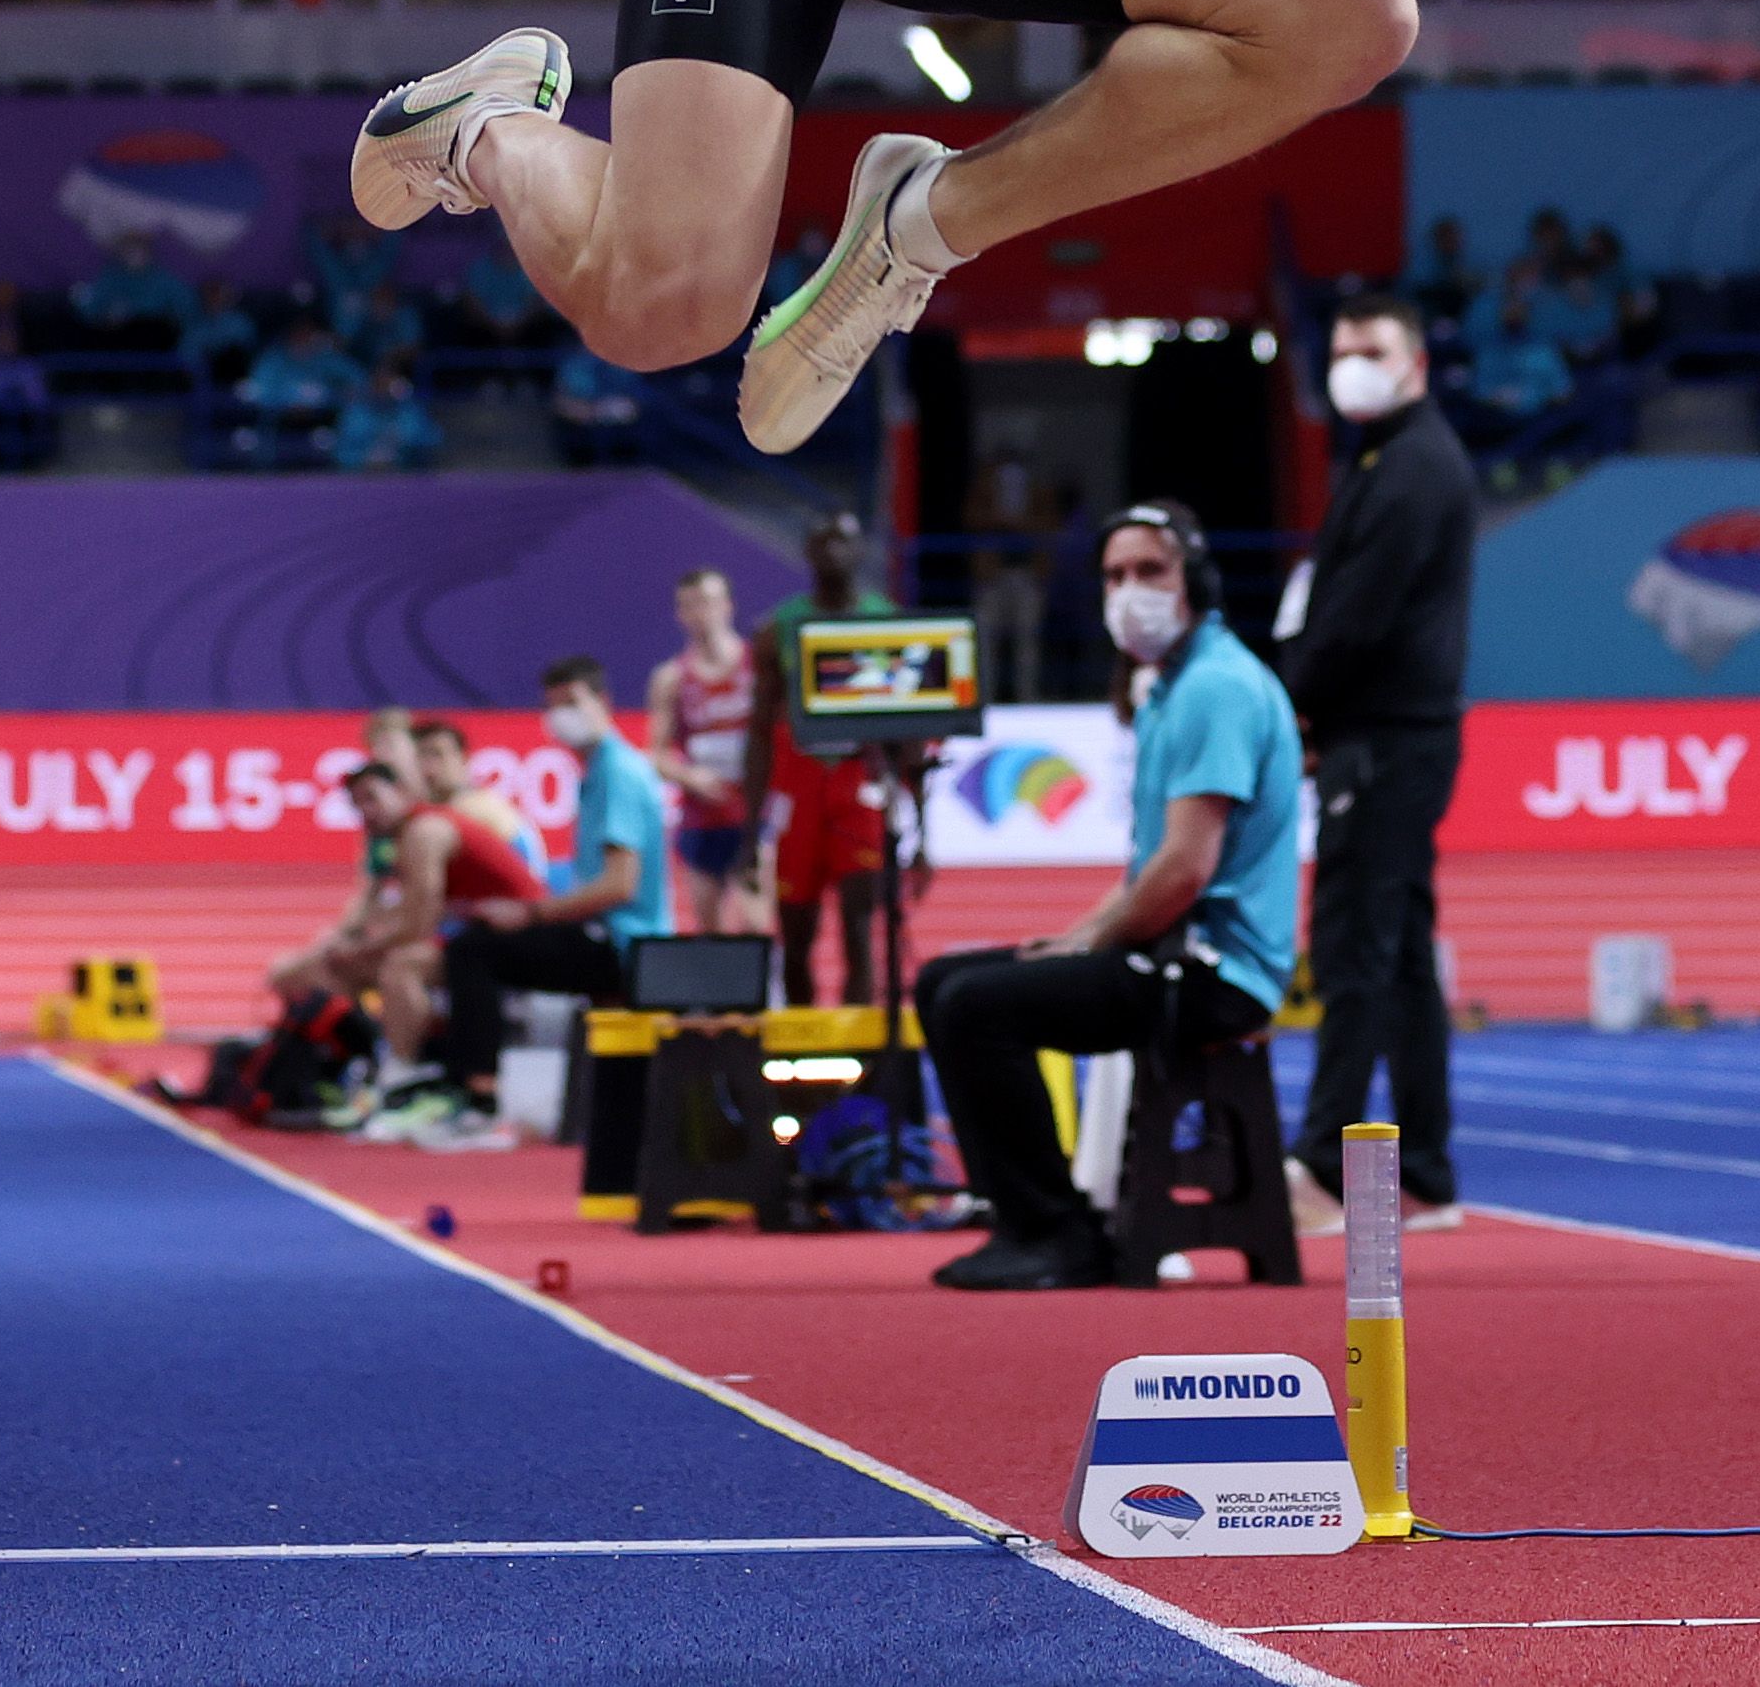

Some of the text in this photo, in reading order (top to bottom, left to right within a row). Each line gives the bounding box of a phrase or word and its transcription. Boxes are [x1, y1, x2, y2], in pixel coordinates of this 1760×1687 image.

[1522, 733, 1748, 818] JULY
[169, 747, 365, 831] 15-2
[1162, 1374, 1301, 1400] MONDO
[1216, 1491, 1341, 1504] WORLD ATHLETICS
[1218, 1514, 1342, 1529] BELGRADE 22
